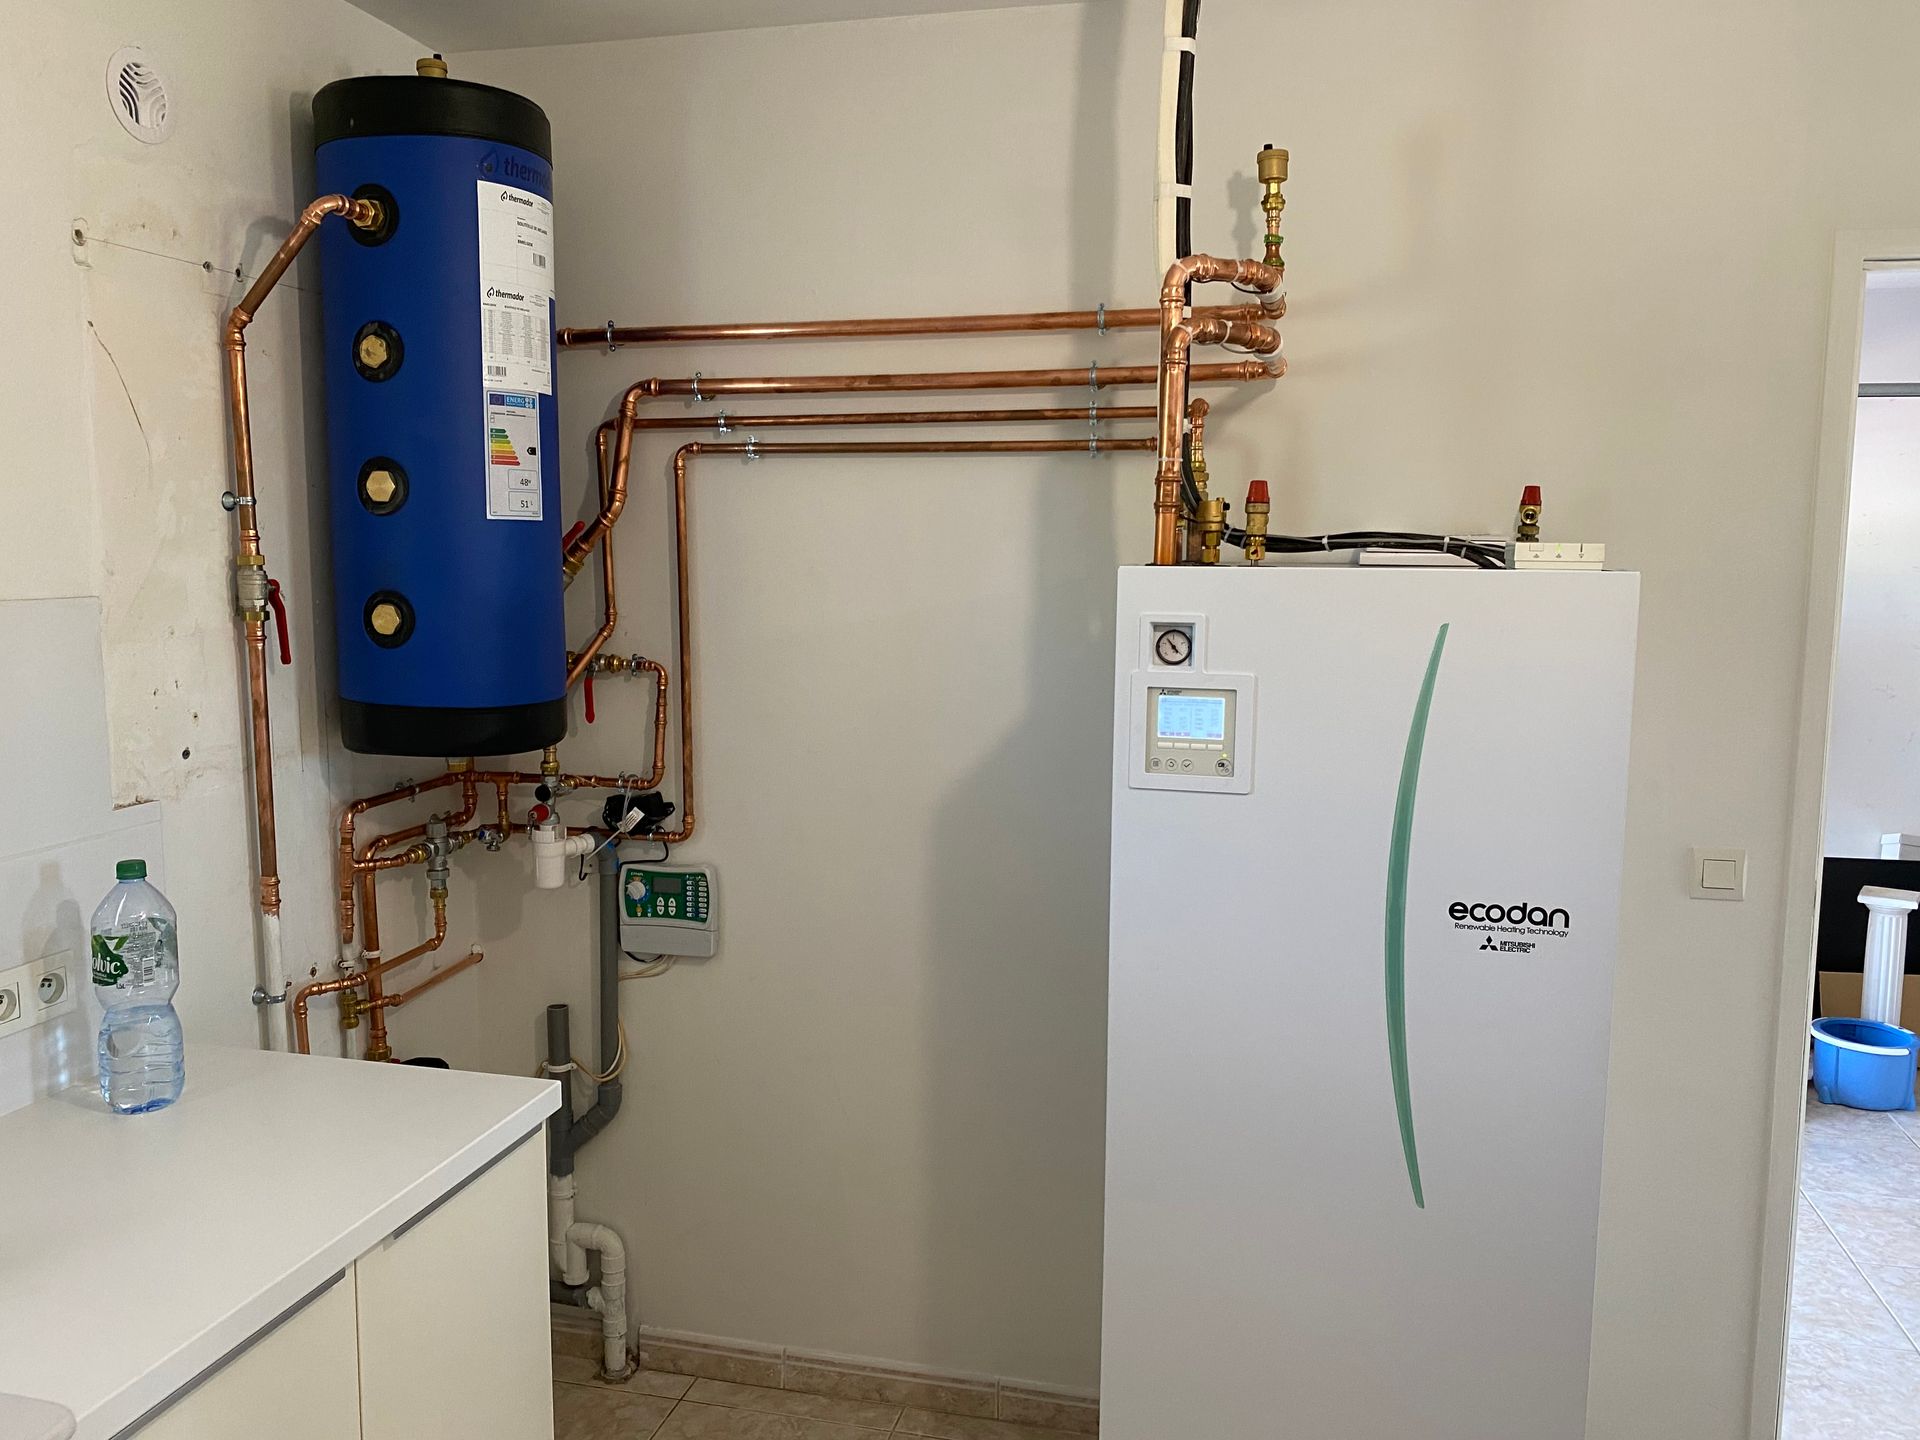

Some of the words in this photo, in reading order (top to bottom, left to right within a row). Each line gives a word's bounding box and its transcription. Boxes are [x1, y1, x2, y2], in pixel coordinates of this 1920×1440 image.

[504, 156, 547, 188] therm
[508, 193, 534, 208] thermador
[495, 289, 525, 301] thermador
[506, 396, 525, 404] ENERG
[520, 500, 529, 508] 51
[1448, 901, 1570, 928] ecodan
[1454, 922, 1496, 932] Renewable
[1497, 925, 1526, 935] Heating
[1527, 927, 1569, 938] Technology
[1500, 940, 1536, 949] MITSUBISHI
[92, 952, 121, 975] olvic
